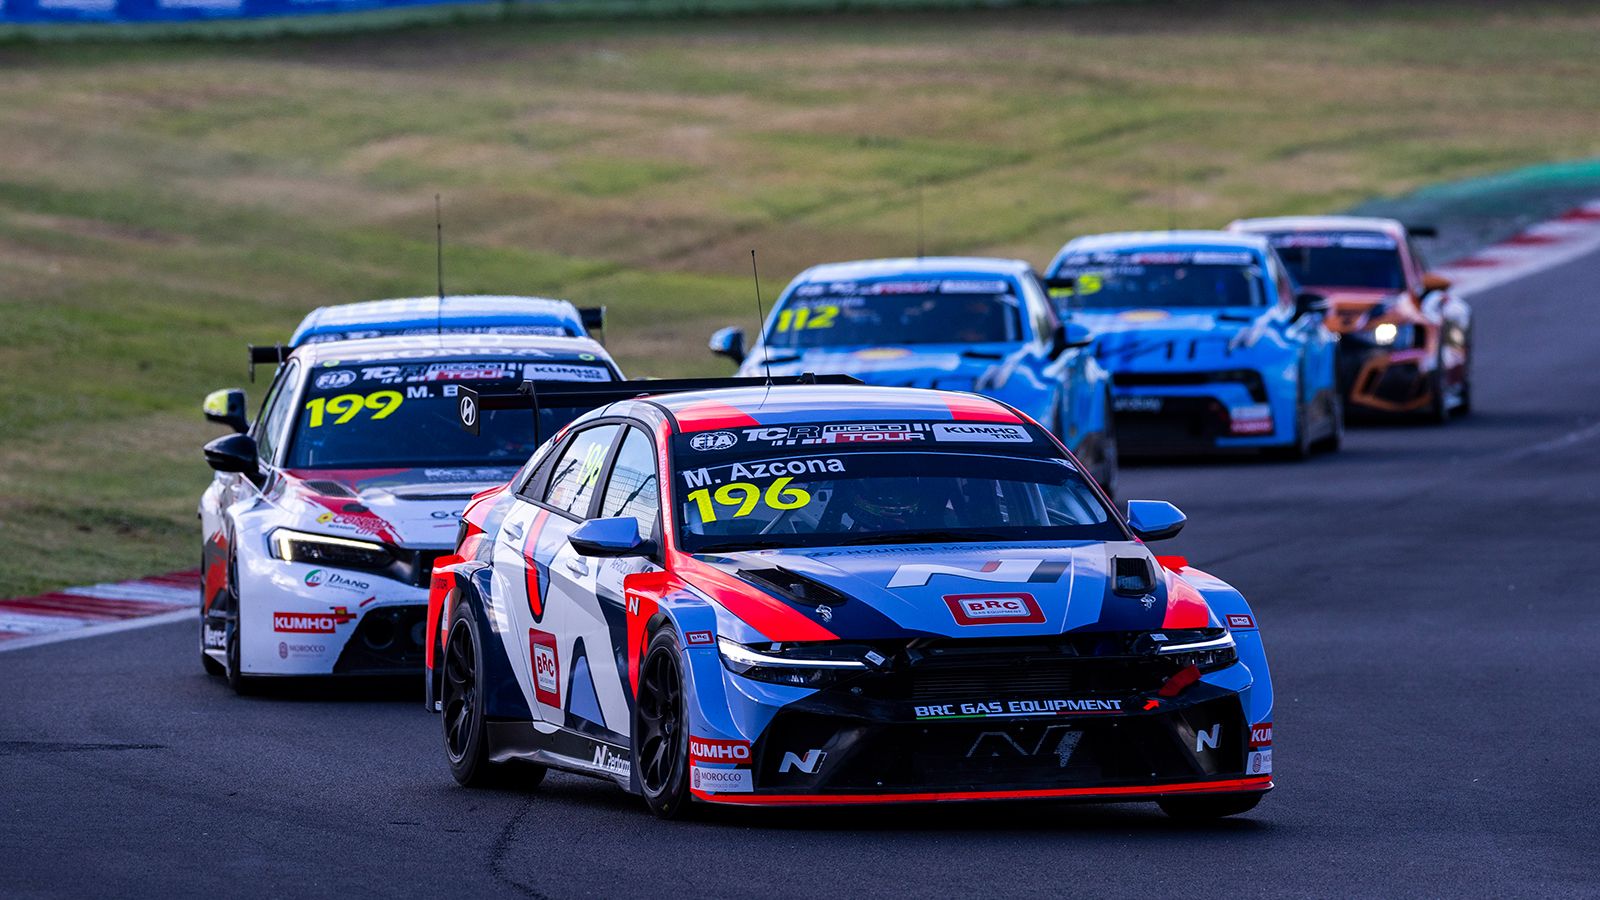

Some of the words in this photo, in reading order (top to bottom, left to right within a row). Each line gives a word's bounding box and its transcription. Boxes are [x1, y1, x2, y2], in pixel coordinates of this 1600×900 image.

[776, 304, 839, 333] 112
[317, 371, 355, 387] FIA
[534, 366, 601, 375] KUMHO
[406, 386, 435, 399] M.
[306, 391, 403, 428] 199
[742, 425, 820, 441] TCR
[828, 424, 905, 432] WORLD
[943, 426, 1020, 435] KUMHO
[691, 433, 735, 450] FIA
[841, 433, 926, 441] TOUR
[682, 467, 722, 488] M.
[730, 459, 847, 482] Azcona
[687, 476, 811, 524] 196
[329, 573, 370, 590] DIANO
[628, 596, 640, 616] N
[968, 600, 1020, 611] BRC
[275, 616, 333, 630] KUMHO
[536, 652, 555, 678] BRC
[914, 704, 956, 718] BRC
[961, 702, 1003, 715] GAS
[1007, 700, 1122, 713] EQUIPMENT
[1196, 723, 1220, 752] N
[690, 741, 750, 759] KUMHO
[778, 749, 826, 774] N
[701, 771, 742, 783] MOROCCO
